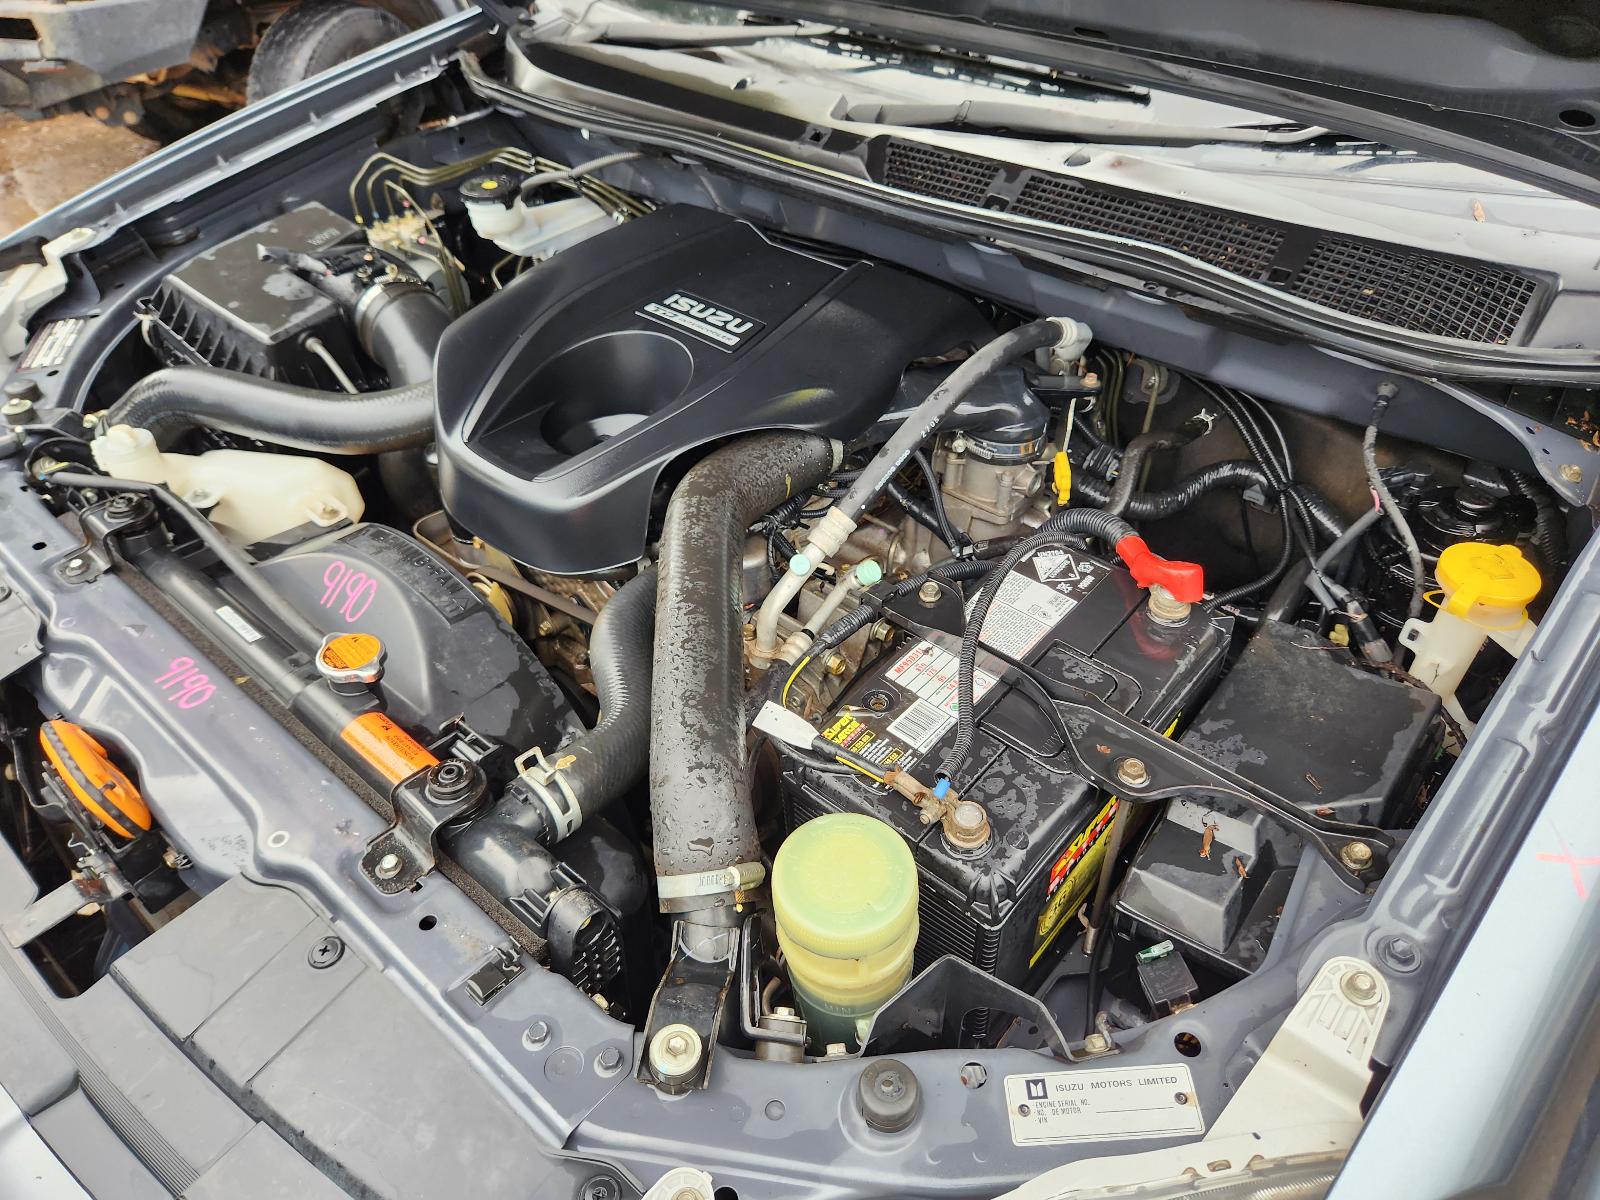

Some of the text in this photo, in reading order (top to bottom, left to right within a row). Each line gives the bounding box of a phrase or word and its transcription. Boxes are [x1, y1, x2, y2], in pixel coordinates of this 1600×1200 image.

[663, 293, 754, 334] ISUZU
[1055, 1076, 1178, 1092] ISUZU MOTORS LIMITED
[1035, 1100, 1057, 1109] ENGINE
[1057, 1098, 1078, 1107] SERIAL
